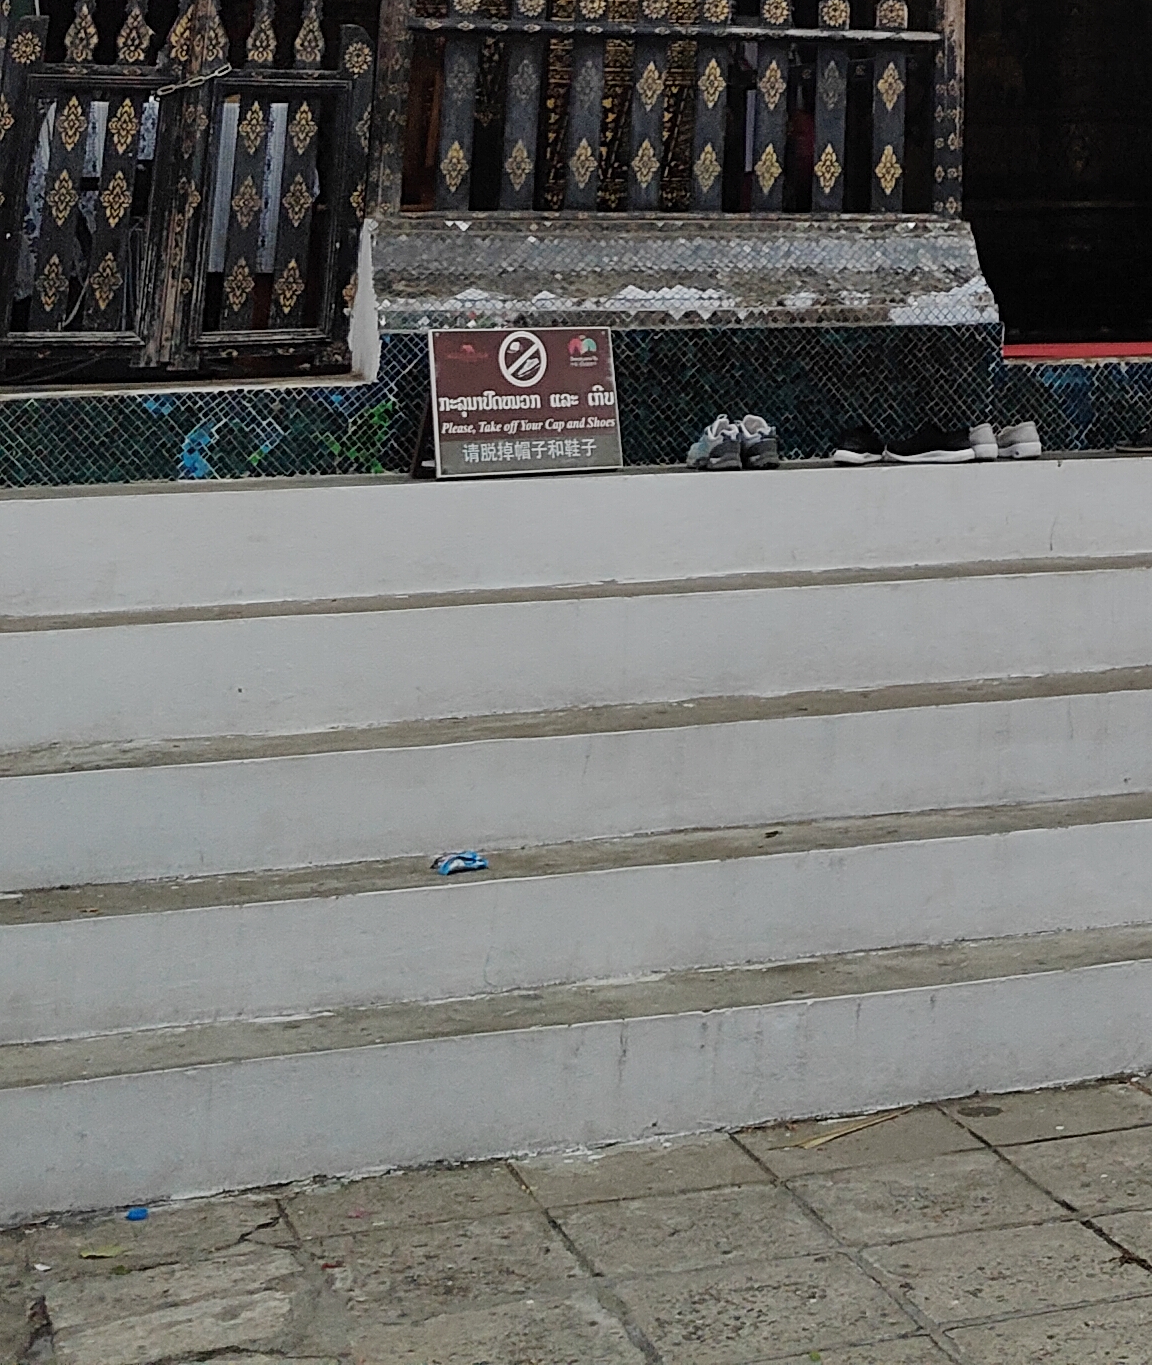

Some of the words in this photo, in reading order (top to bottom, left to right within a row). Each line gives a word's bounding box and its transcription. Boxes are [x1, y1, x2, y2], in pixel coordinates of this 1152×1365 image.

[440, 421, 477, 436] Please,
[478, 421, 503, 433] Take
[503, 420, 519, 435] off
[520, 419, 543, 431] Your
[544, 417, 565, 432] Cap
[566, 417, 586, 429] and
[586, 416, 616, 428] Shoes
[461, 438, 597, 463] 请脱掉帽子和鞋子
